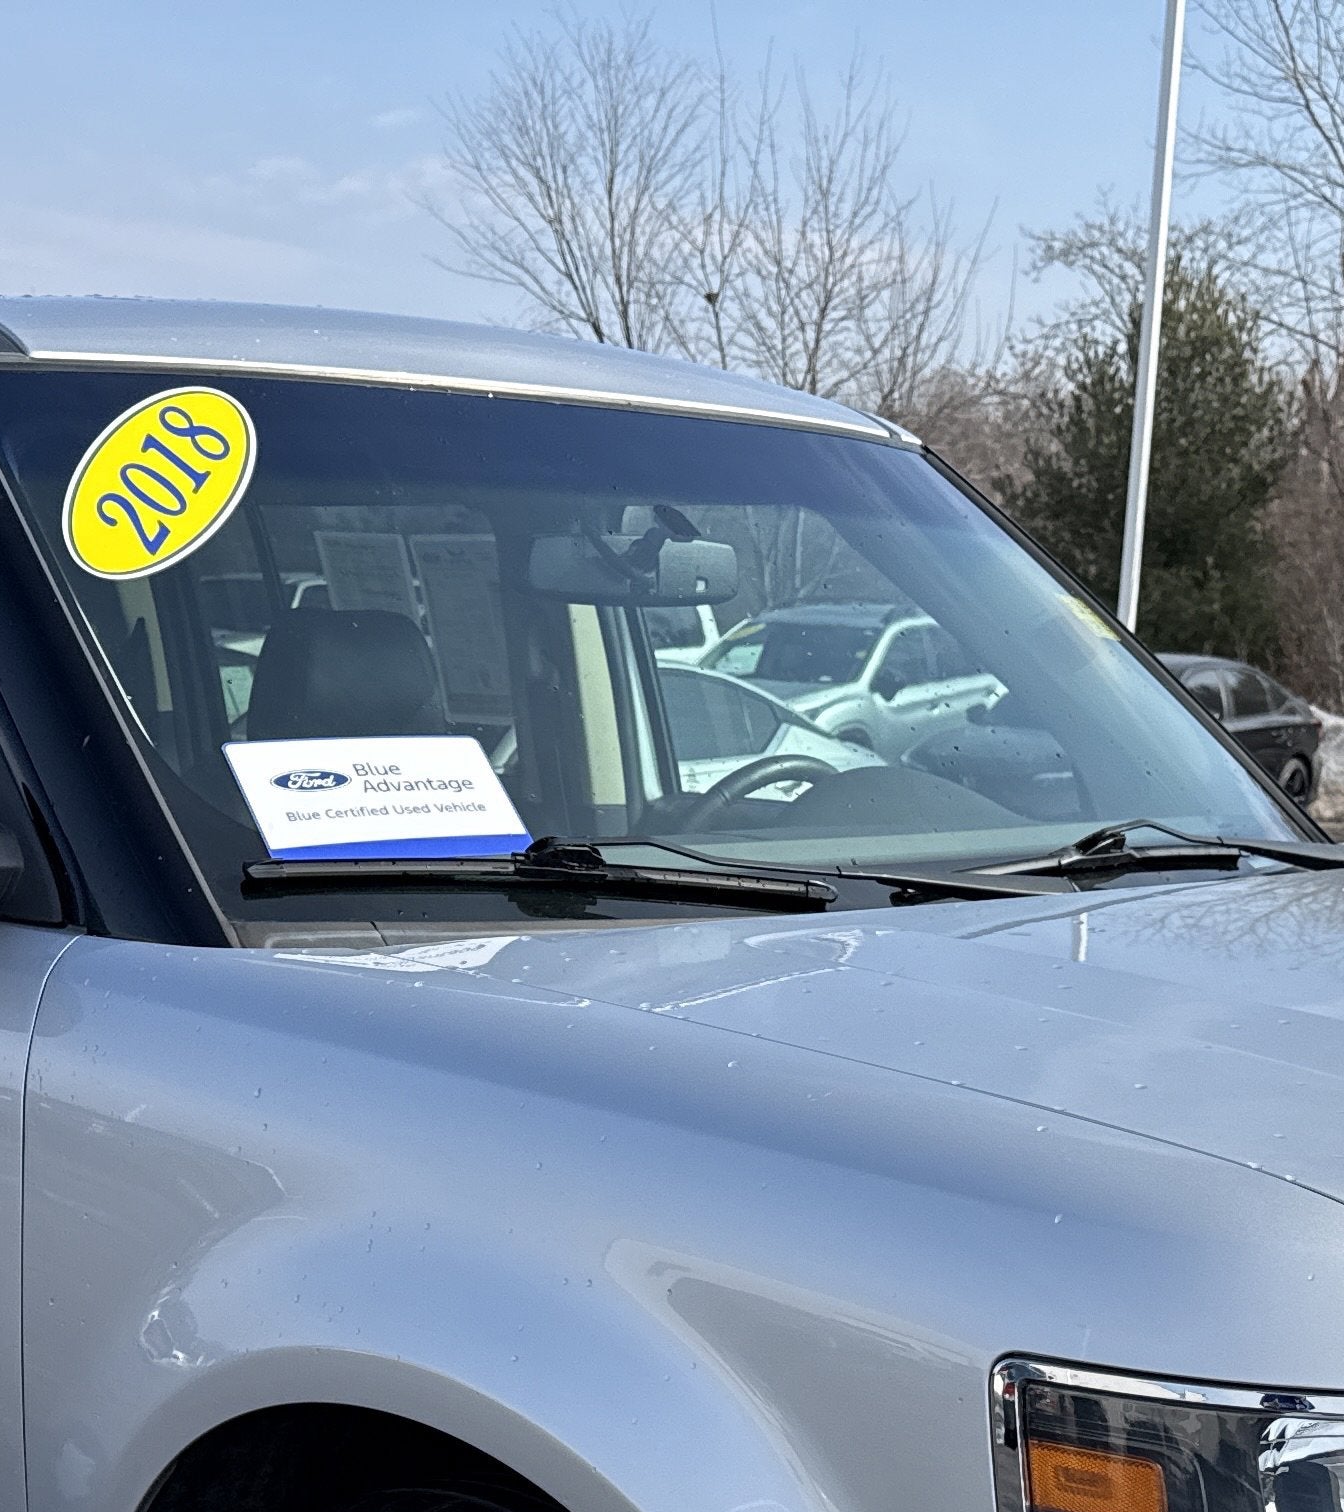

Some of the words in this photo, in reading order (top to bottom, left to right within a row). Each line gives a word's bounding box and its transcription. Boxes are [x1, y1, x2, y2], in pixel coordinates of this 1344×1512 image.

[95, 405, 232, 556] 2018
[352, 762, 402, 777] Blue
[363, 778, 475, 793] Advantage
[286, 811, 321, 822] Blue
[325, 805, 390, 820] Certified
[392, 803, 432, 815] Used
[433, 801, 487, 813] Vehicle
